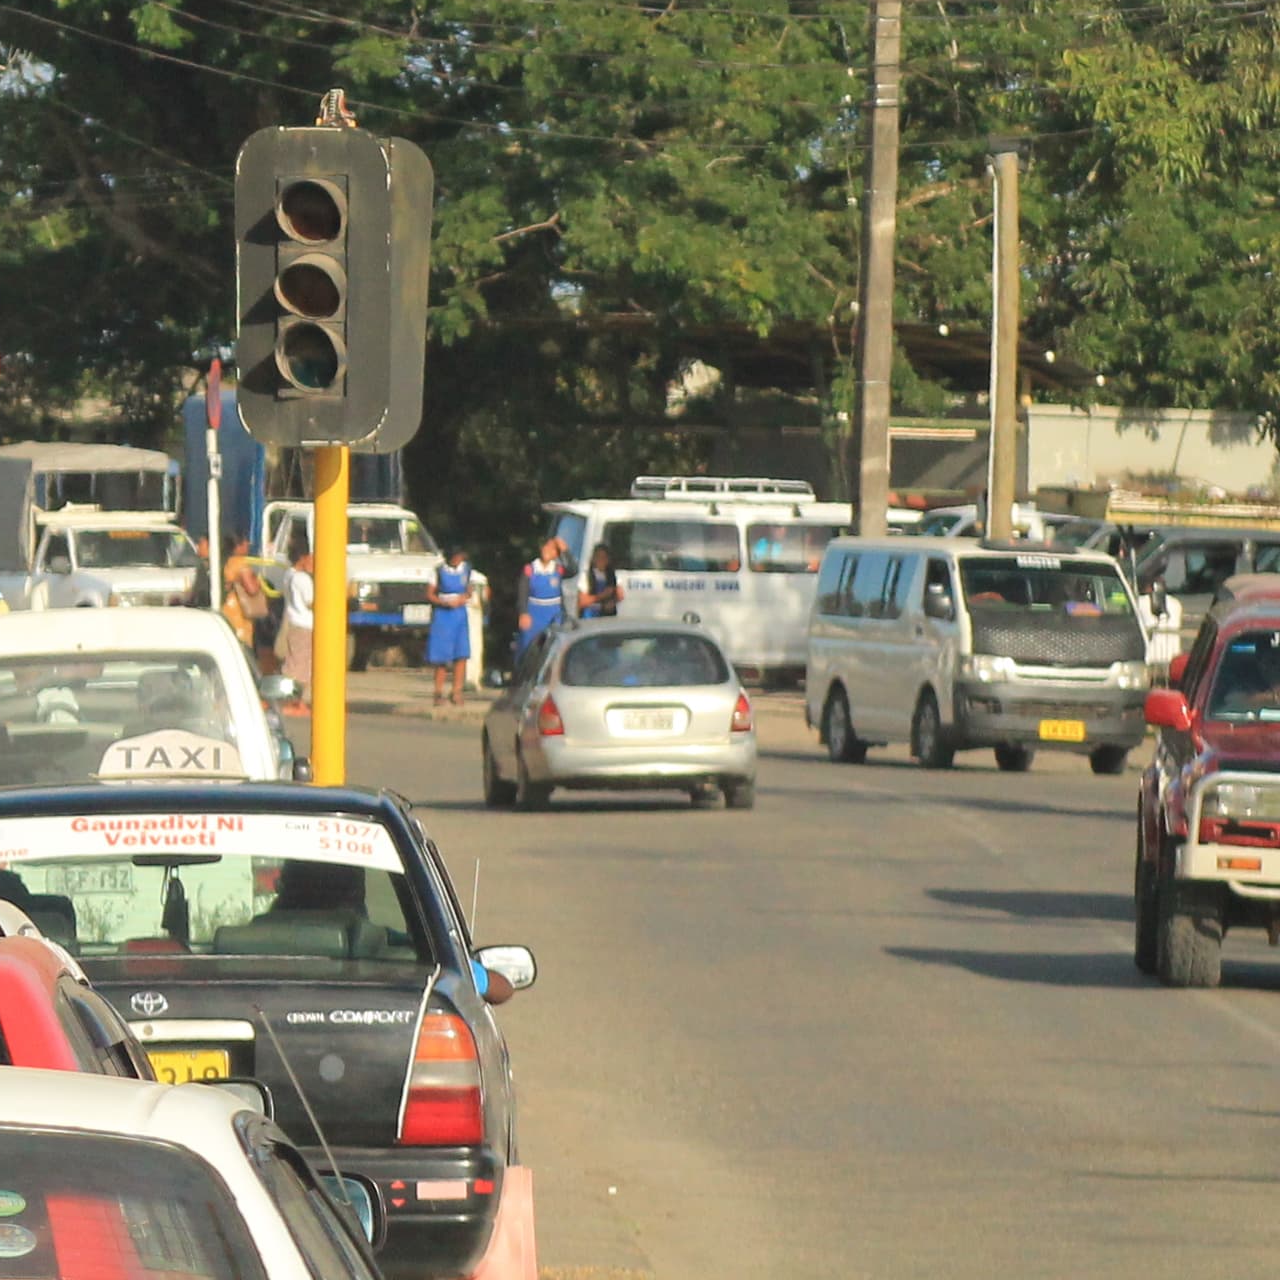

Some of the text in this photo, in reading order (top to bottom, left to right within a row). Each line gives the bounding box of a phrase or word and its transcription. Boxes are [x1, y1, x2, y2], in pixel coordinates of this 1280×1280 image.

[117, 746, 222, 770] TAXI
[71, 814, 244, 833] Gaunadivi Ni
[319, 837, 374, 856] 5108
[329, 1010, 414, 1024] COMFORT
